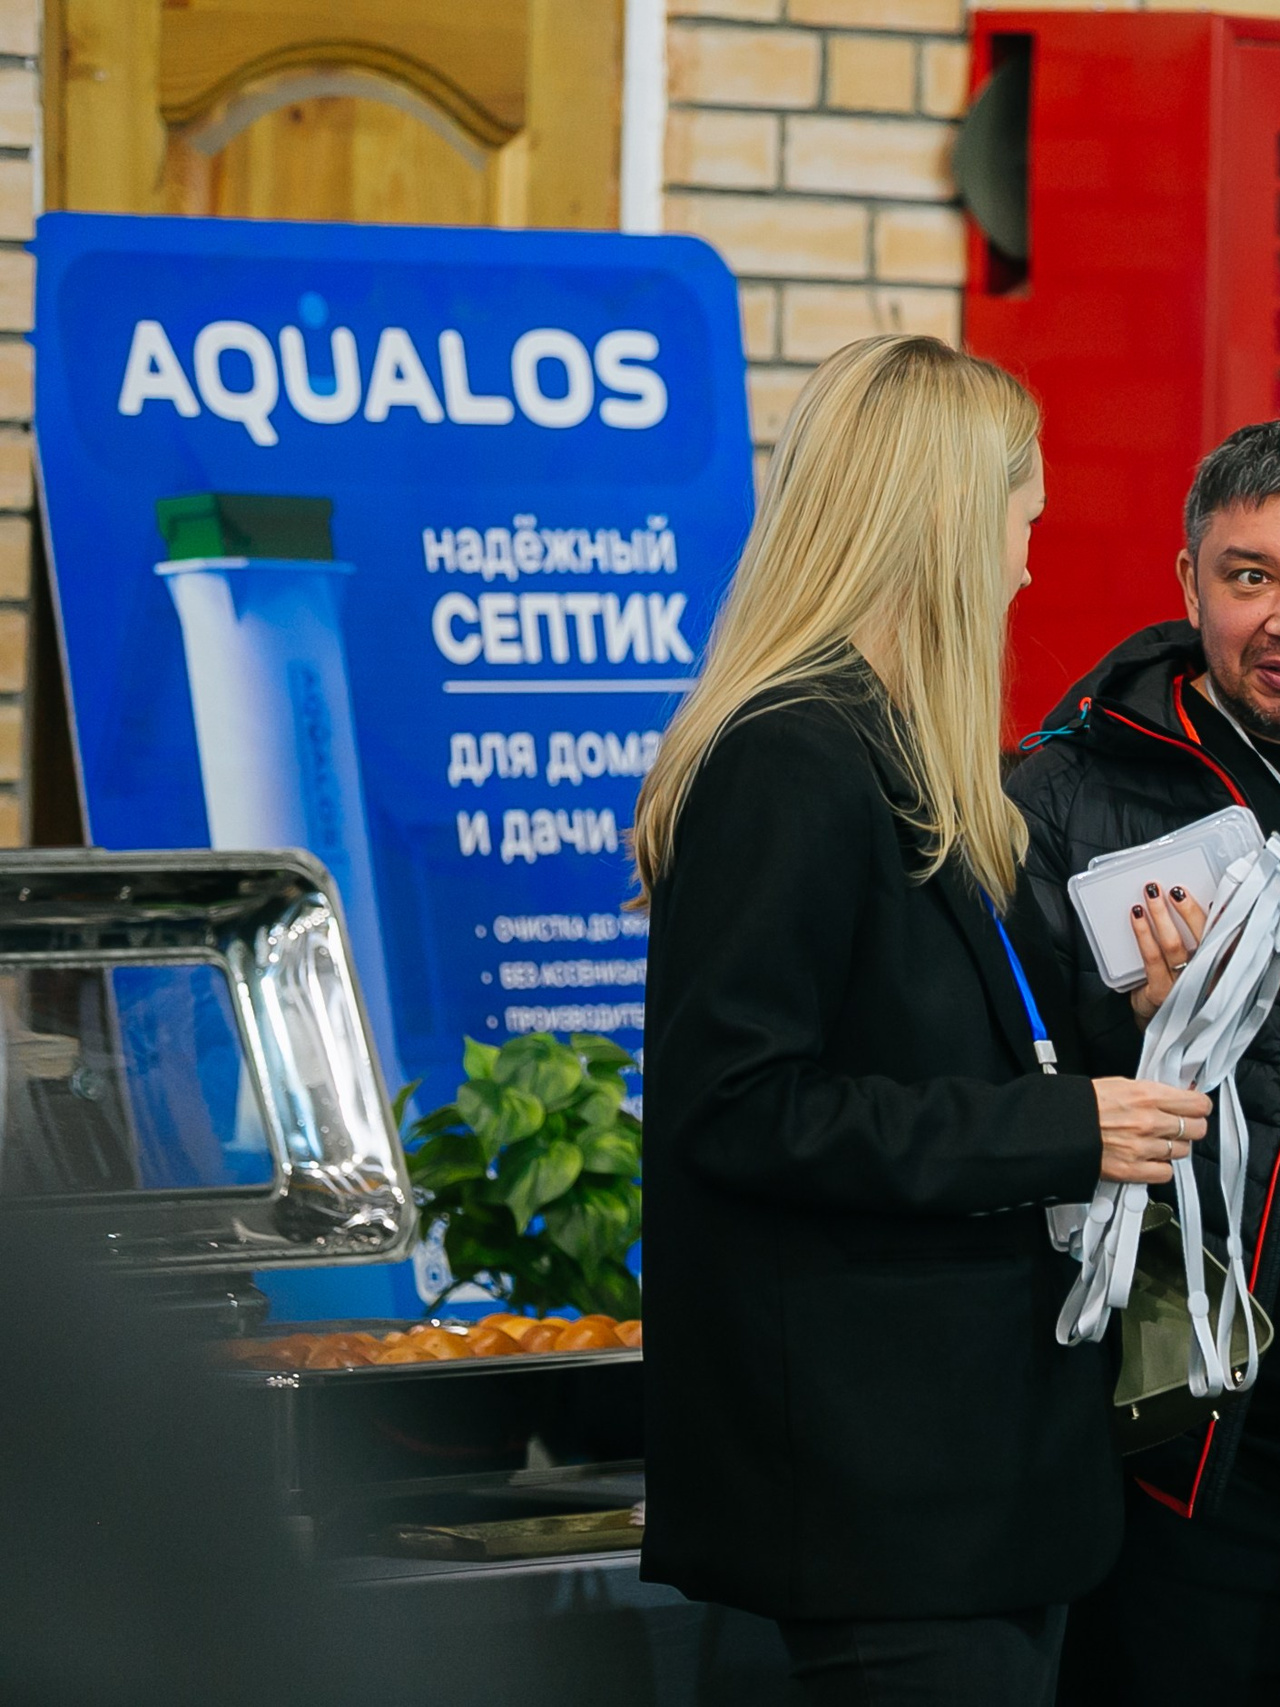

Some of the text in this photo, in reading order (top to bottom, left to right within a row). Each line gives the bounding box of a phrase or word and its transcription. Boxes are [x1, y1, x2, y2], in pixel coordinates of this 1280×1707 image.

[118, 319, 669, 447] AQUALOS
[422, 513, 678, 583] надёжный
[432, 591, 695, 665] СЕПТИК
[448, 731, 537, 787] для
[456, 808, 619, 864] и дачи
